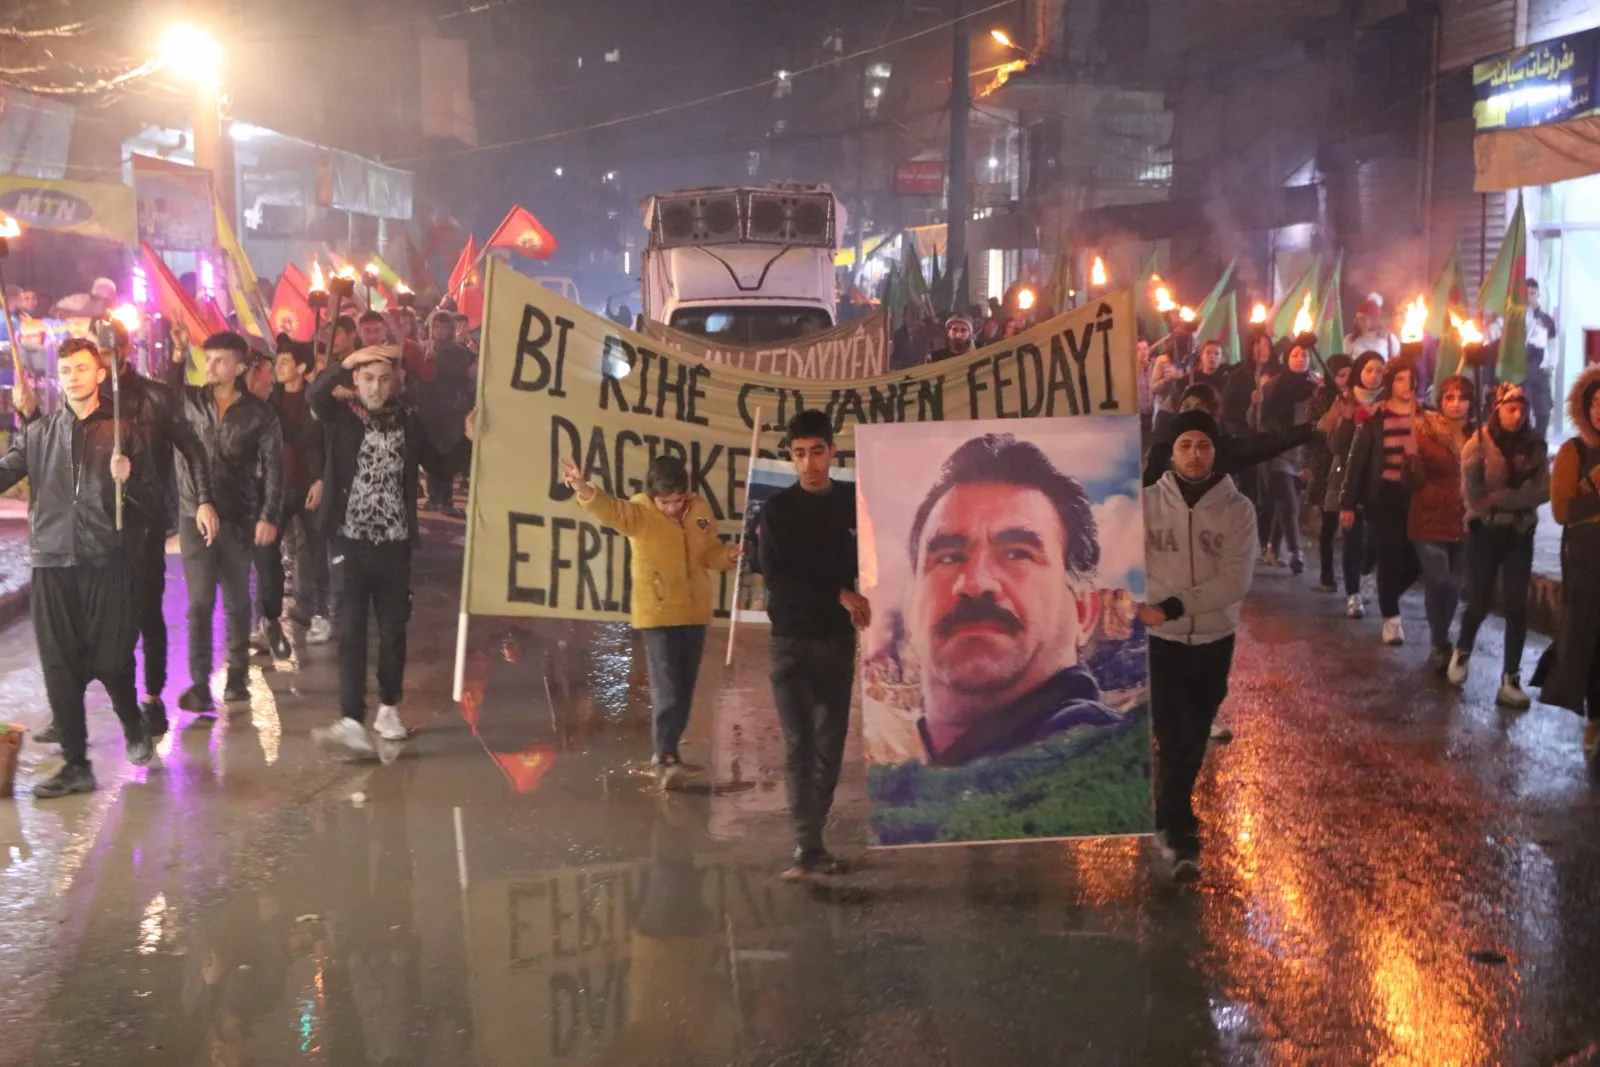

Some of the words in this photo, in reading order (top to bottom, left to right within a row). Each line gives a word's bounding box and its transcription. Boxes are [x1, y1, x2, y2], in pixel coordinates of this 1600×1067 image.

[16, 193, 76, 221] MTN
[510, 303, 575, 398] BI
[968, 303, 1119, 420] FEDAYÎ
[507, 511, 642, 614] EFRI
